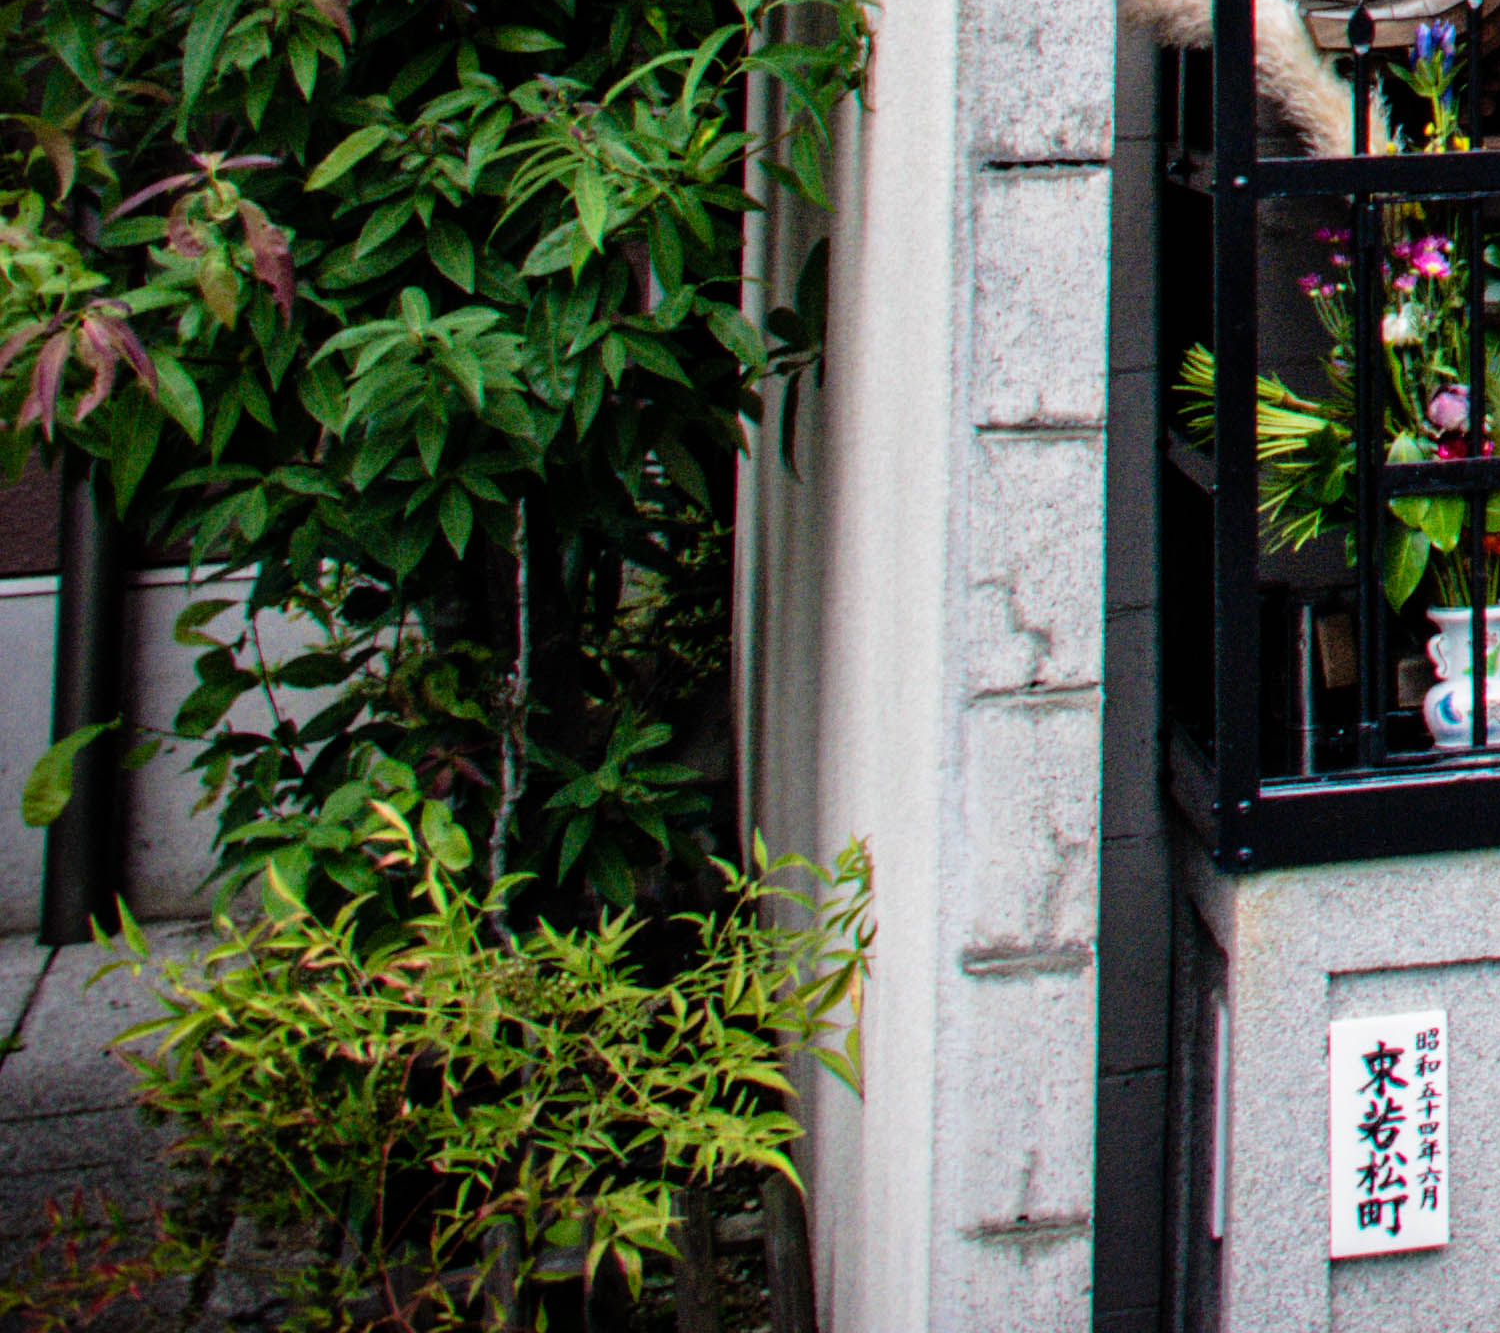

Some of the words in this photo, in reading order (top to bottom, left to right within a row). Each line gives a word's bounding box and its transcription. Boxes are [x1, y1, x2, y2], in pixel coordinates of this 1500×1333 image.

[1356, 1040, 1410, 1237] 東若松町
[1414, 1027, 1442, 1212] 昭和五十四年六月
